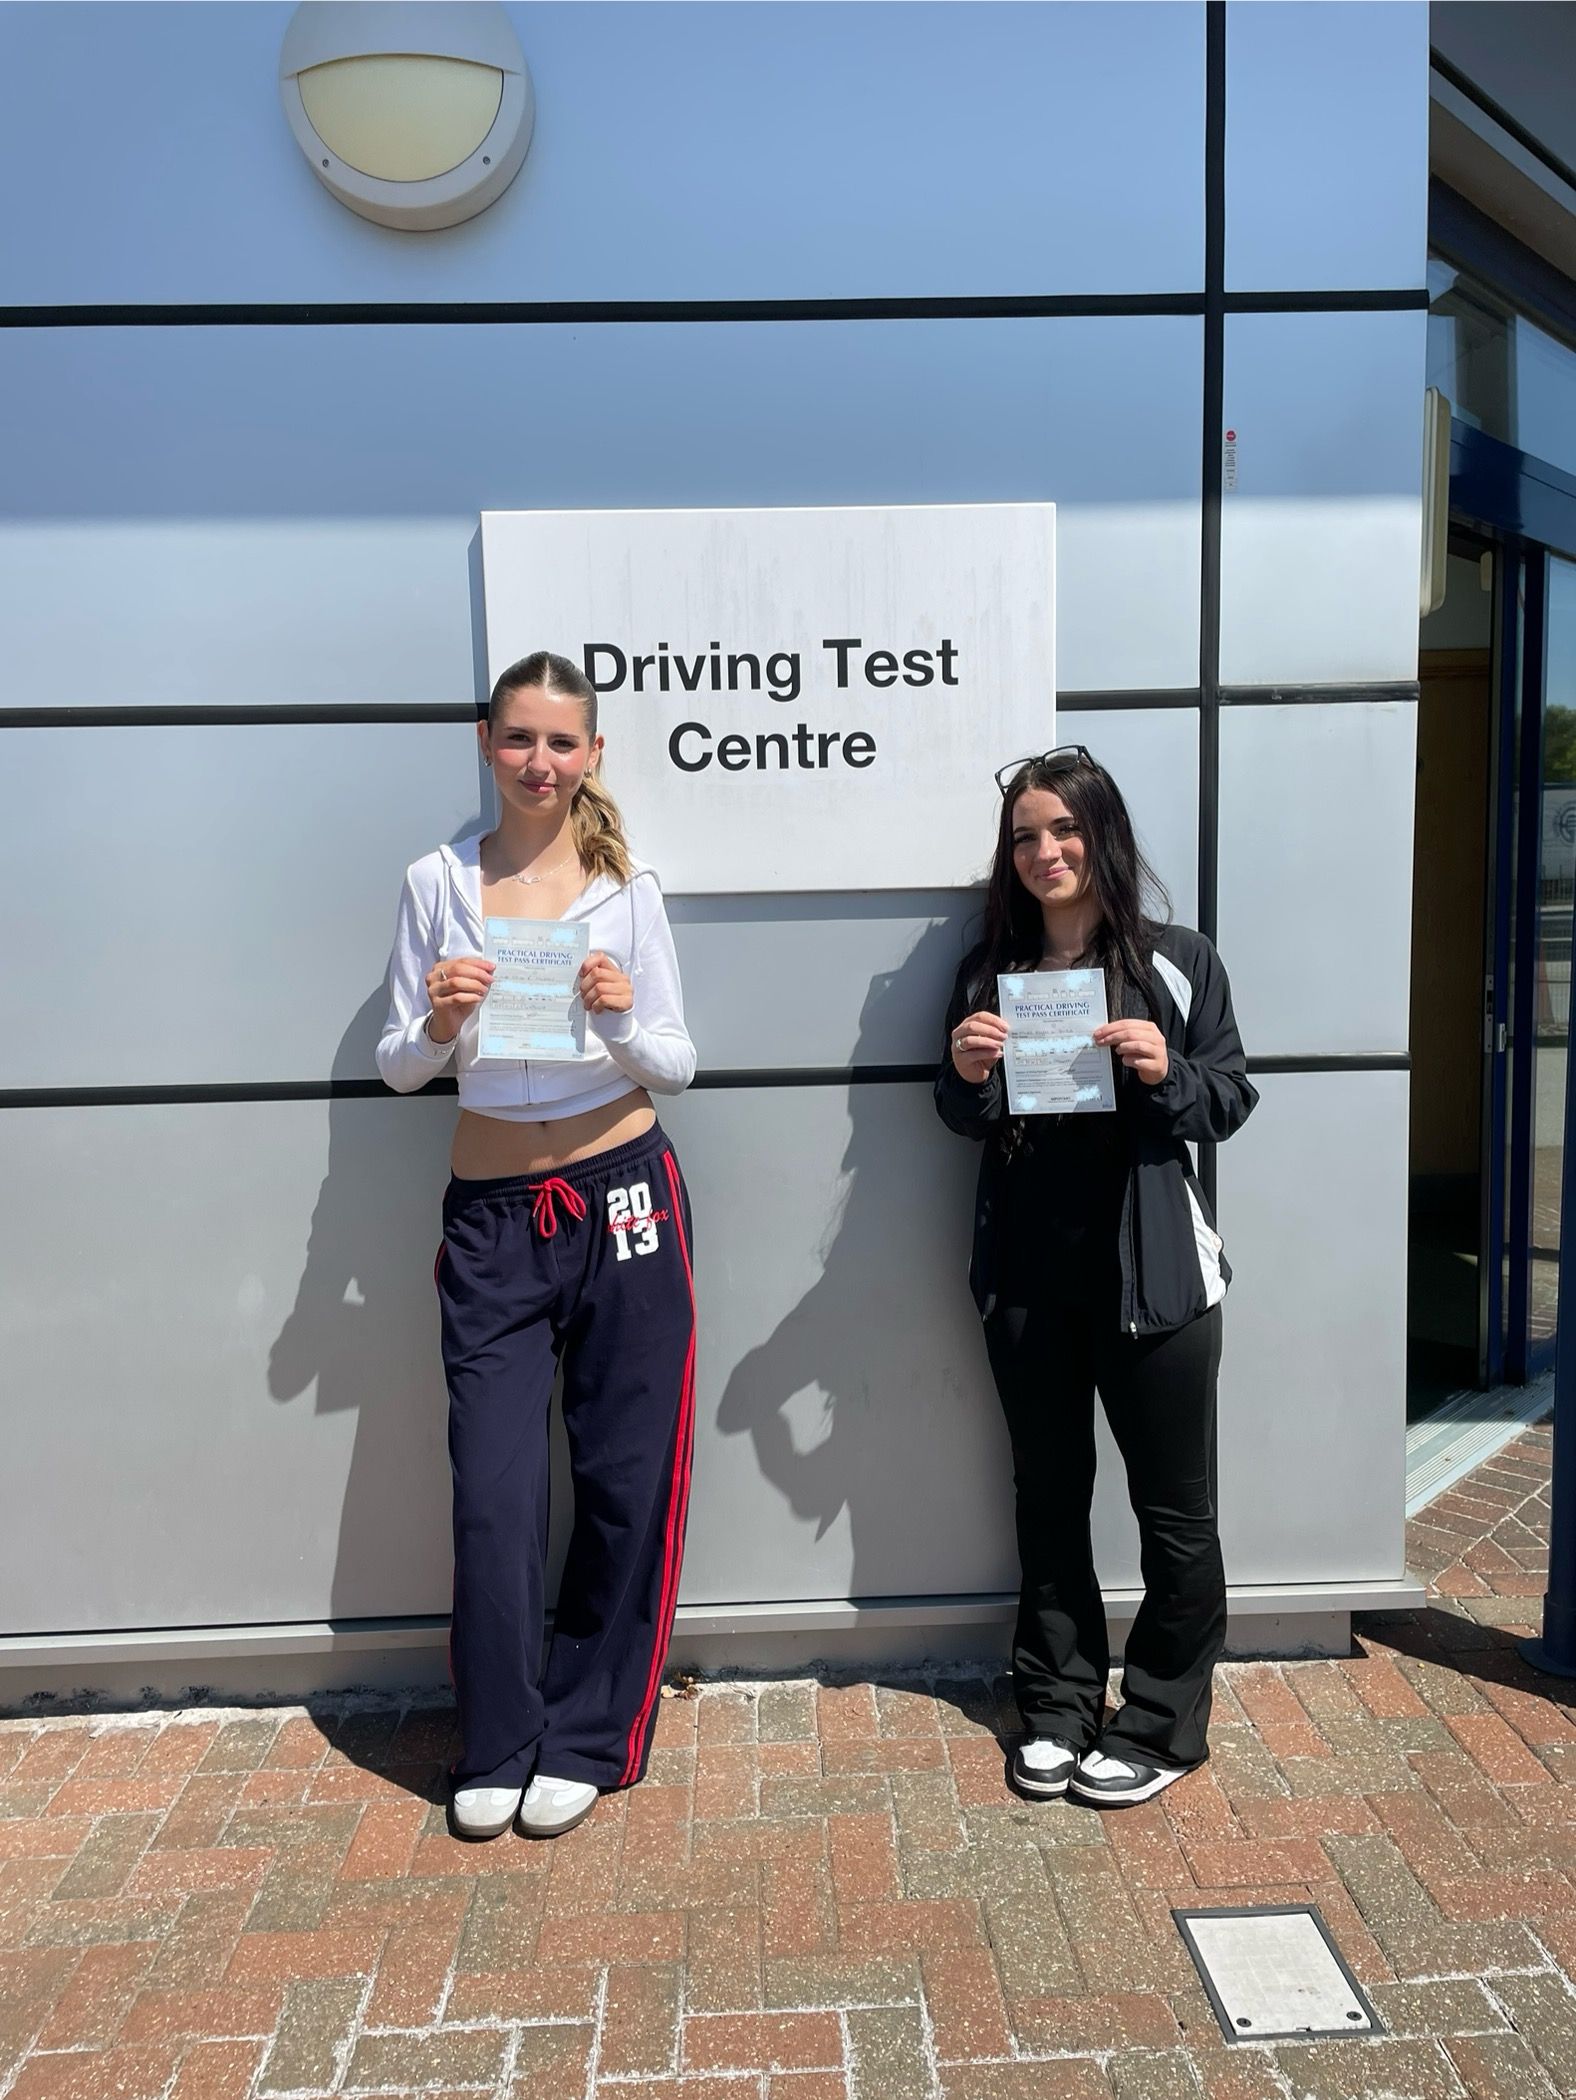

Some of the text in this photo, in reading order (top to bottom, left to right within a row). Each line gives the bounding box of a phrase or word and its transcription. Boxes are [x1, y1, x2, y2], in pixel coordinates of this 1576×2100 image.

[583, 639, 959, 702] Driving Test
[668, 721, 877, 773] Centre
[497, 949, 573, 959] PRACTICAL DRIVING
[531, 958, 572, 966] CERTIFICATE
[1015, 1001, 1090, 1012] PRACTICAL DRIVING
[1049, 1009, 1089, 1017] CERTIFICATE
[607, 1182, 652, 1225] 20
[612, 1219, 659, 1261] 13
